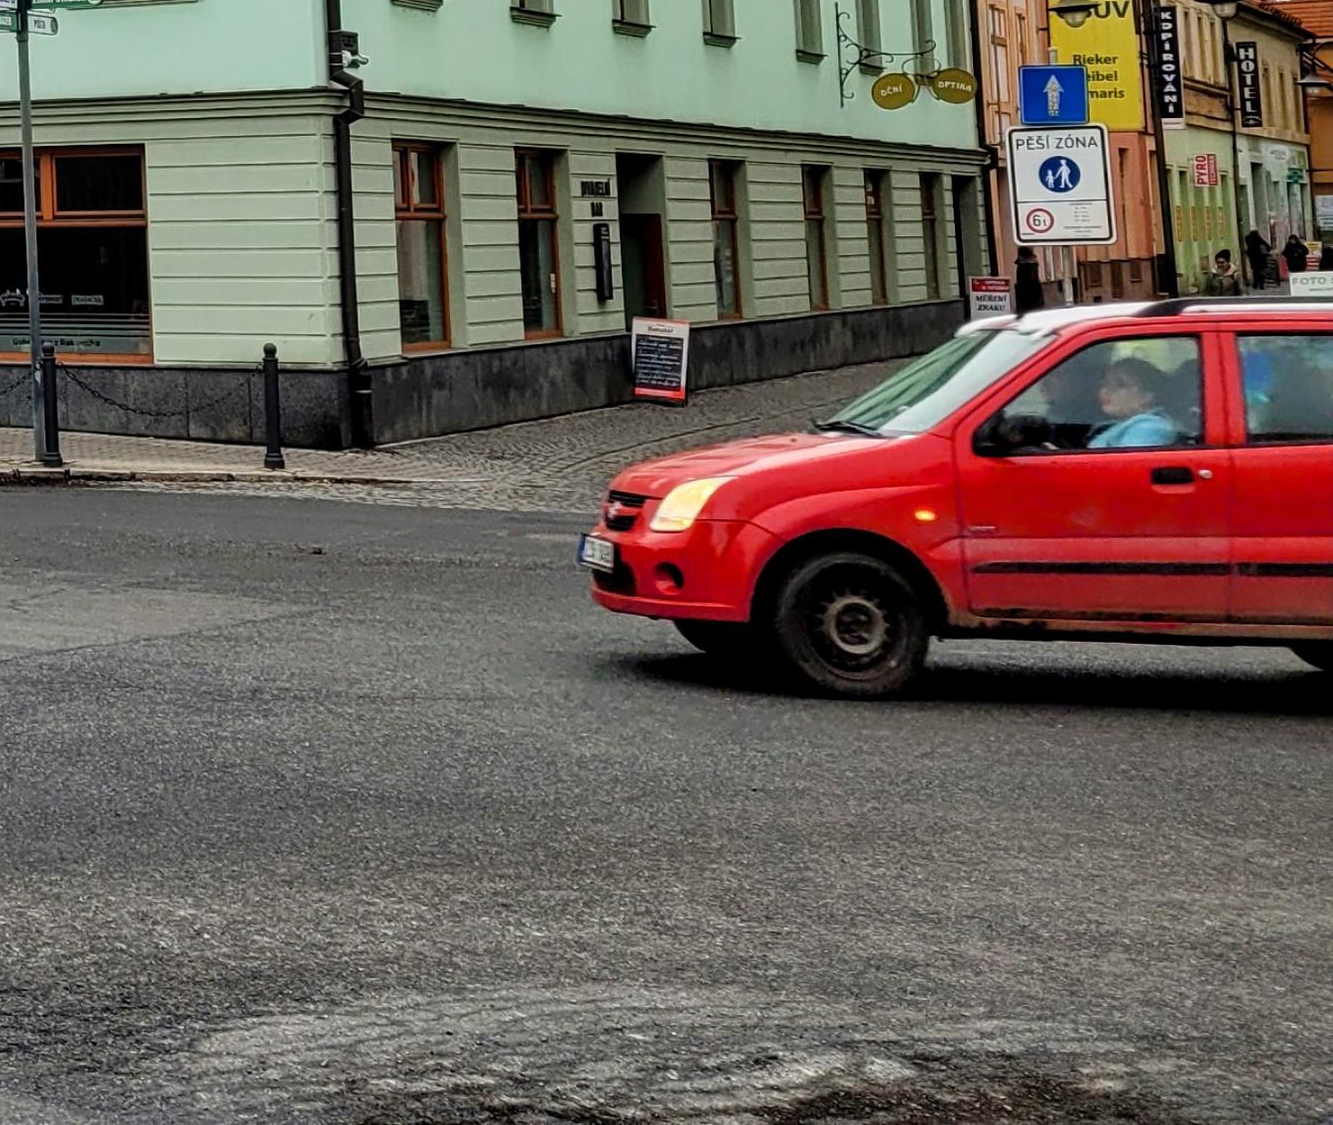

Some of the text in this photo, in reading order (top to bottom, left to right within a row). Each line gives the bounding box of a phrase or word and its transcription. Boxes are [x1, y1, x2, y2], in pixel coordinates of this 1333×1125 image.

[1073, 54, 1118, 65] Rieker
[1087, 70, 1118, 82] eibel
[1238, 47, 1257, 113] HOTEL
[937, 80, 972, 92] OPTIKA
[1015, 133, 1098, 151] PĚŠÍ ZÓNA
[1195, 155, 1208, 185] PYRO
[1292, 277, 1326, 286] FOTO
